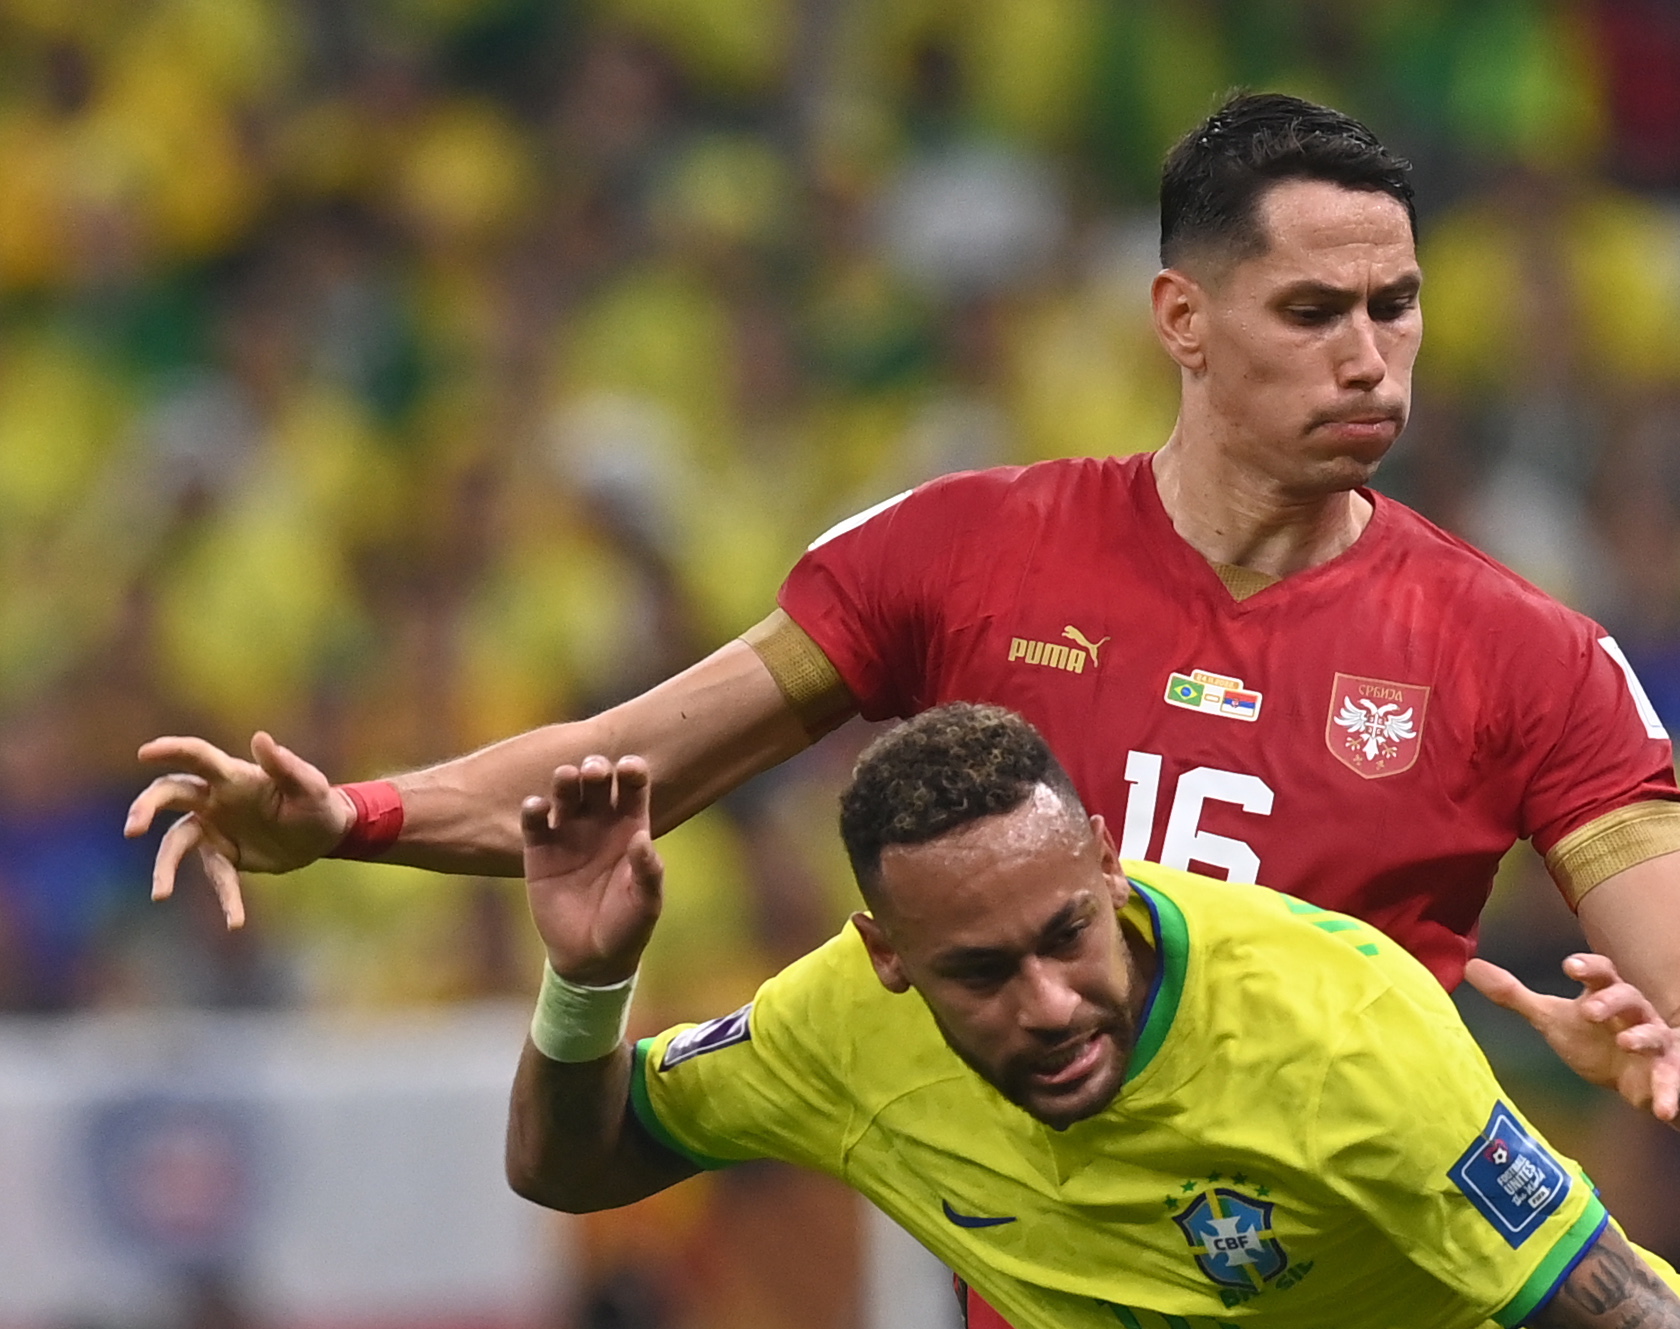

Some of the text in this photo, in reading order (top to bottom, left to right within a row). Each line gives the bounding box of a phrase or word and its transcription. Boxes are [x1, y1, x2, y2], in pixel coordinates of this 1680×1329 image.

[1007, 637, 1087, 675] PUMA
[1358, 684, 1403, 702] СРБИЈА
[1119, 750, 1275, 885] 16
[1503, 1160, 1537, 1196] UNITES
[1213, 1234, 1250, 1253] CBF
